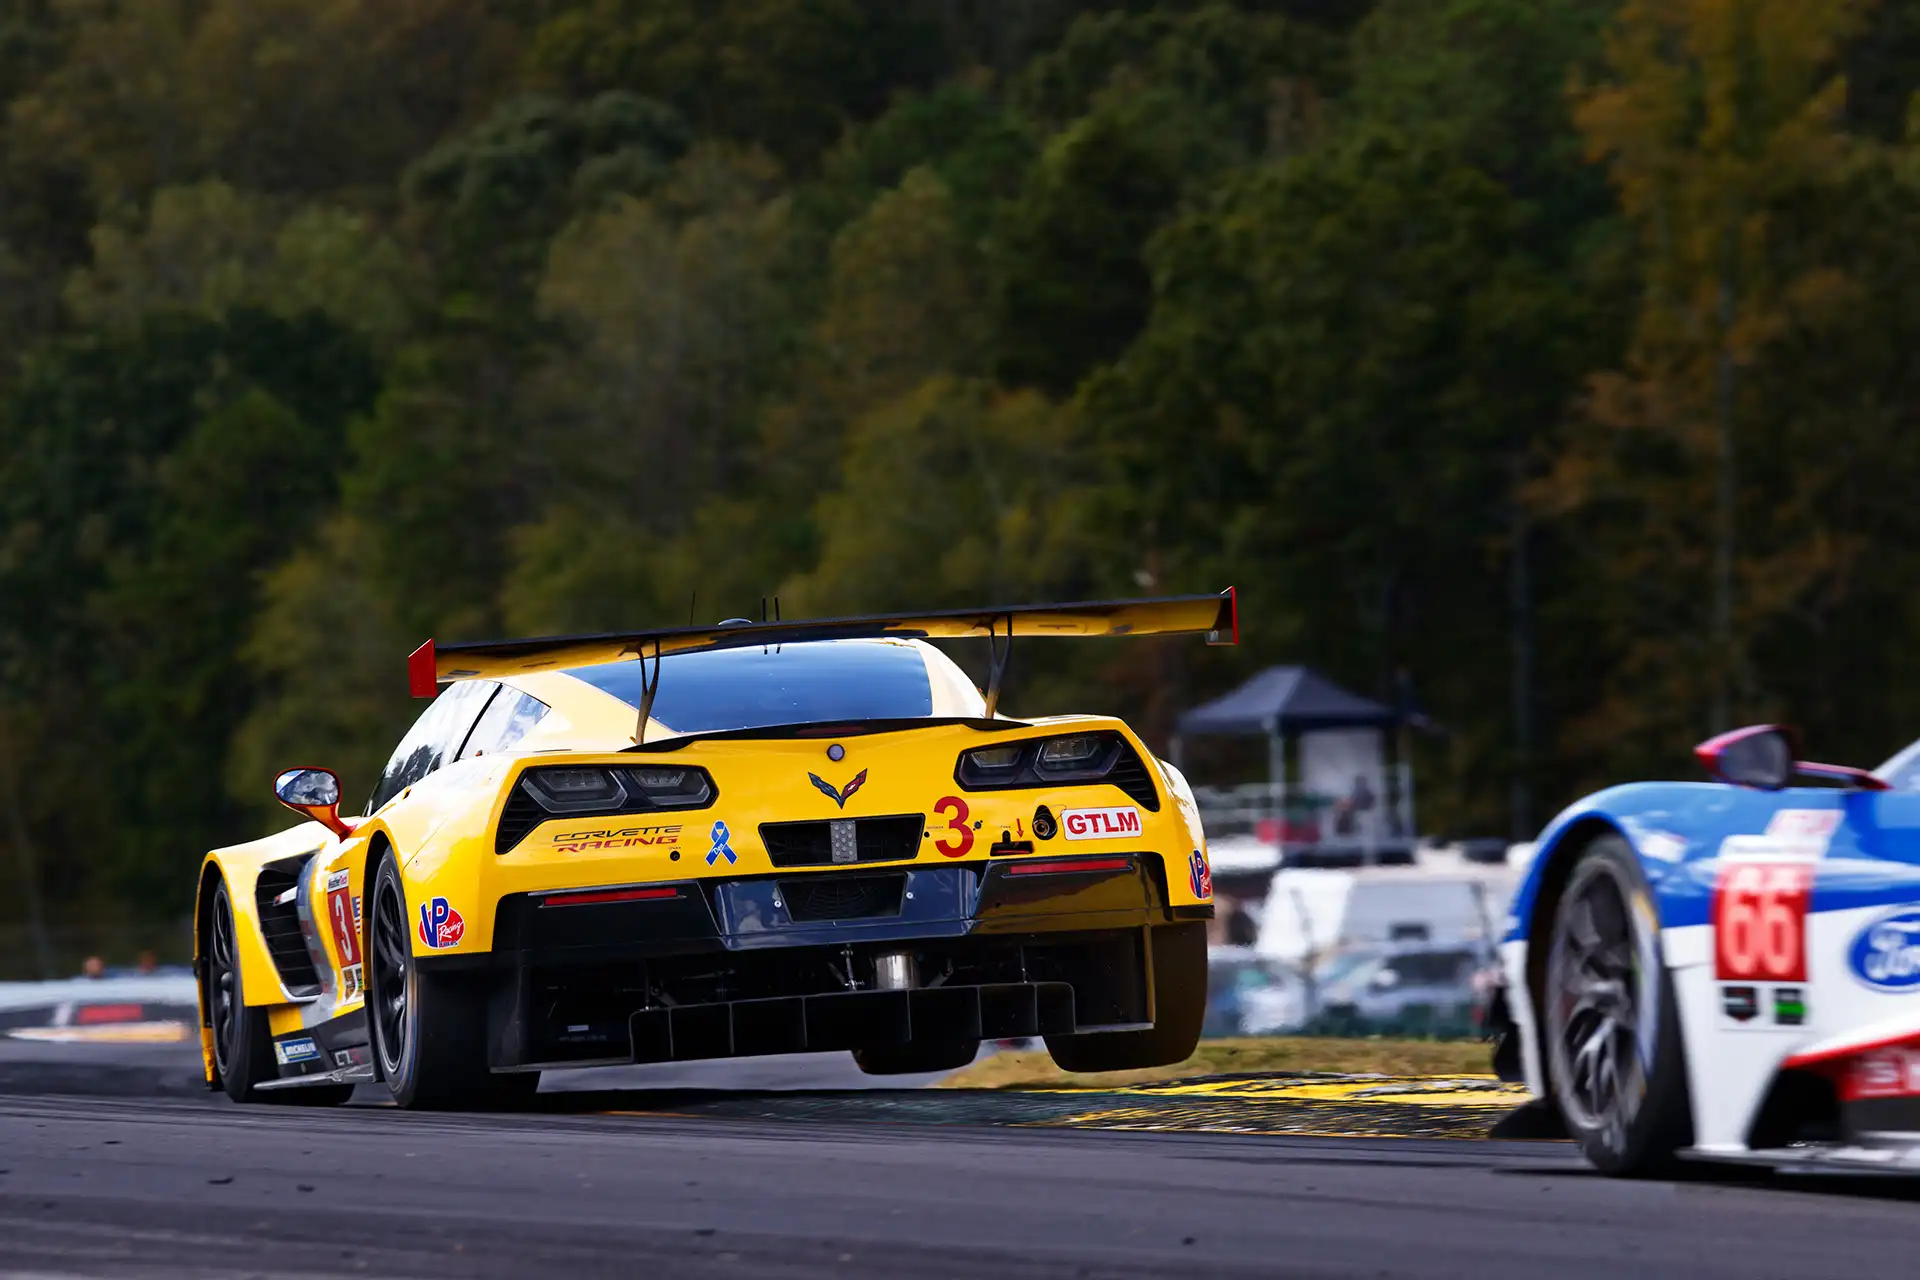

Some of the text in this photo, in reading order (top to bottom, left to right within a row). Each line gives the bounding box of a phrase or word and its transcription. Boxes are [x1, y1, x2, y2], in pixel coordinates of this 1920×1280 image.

[553, 825, 683, 843] CORVETTE
[933, 796, 974, 858] 3
[1066, 812, 1139, 835] GTLM
[552, 835, 679, 853] RACING
[335, 894, 353, 961] 3
[420, 897, 449, 948] VP
[439, 921, 464, 941] Racing
[1721, 865, 1800, 976] 66
